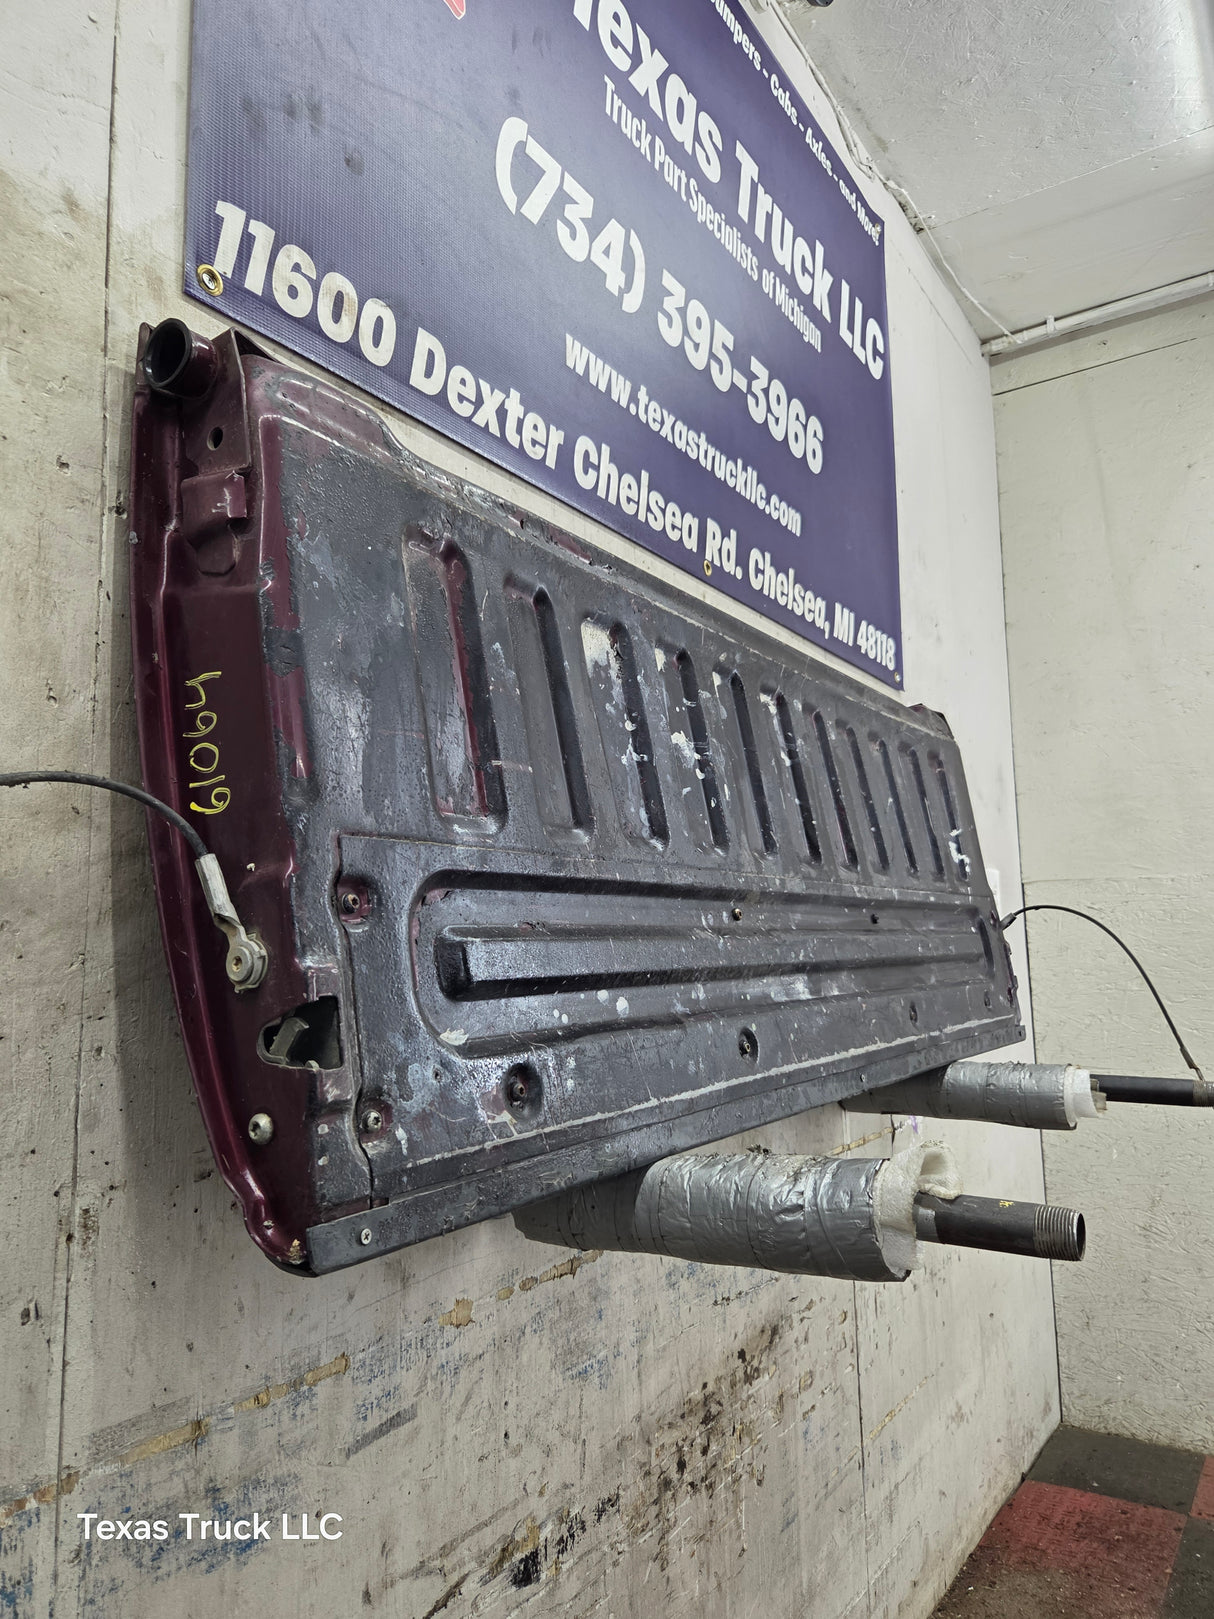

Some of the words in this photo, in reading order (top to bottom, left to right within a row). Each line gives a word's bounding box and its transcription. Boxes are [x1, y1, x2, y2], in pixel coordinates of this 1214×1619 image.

[604, 75, 652, 163] Truck
[654, 135, 688, 202] Part
[689, 178, 758, 281] Specialists
[762, 268, 775, 299] of
[775, 277, 822, 353] Michigan
[710, 0, 761, 71] umpers
[770, 73, 798, 126] Cabs
[805, 127, 833, 176] Axles
[839, 179, 857, 212] and
[495, 116, 646, 313] (734)
[657, 268, 824, 475] 395-3966
[735, 139, 834, 323] Truck
[839, 279, 884, 380] LLC
[214, 200, 397, 367] 11600
[409, 326, 564, 470] Dexter
[573, 435, 699, 553] Chelsea
[705, 517, 743, 580] Rd.
[748, 547, 829, 640] Chelsea,
[834, 602, 855, 647] MI
[856, 624, 896, 671] 48118
[565, 333, 802, 537] www.texastruckllc.com
[183, 671, 231, 815] 61064
